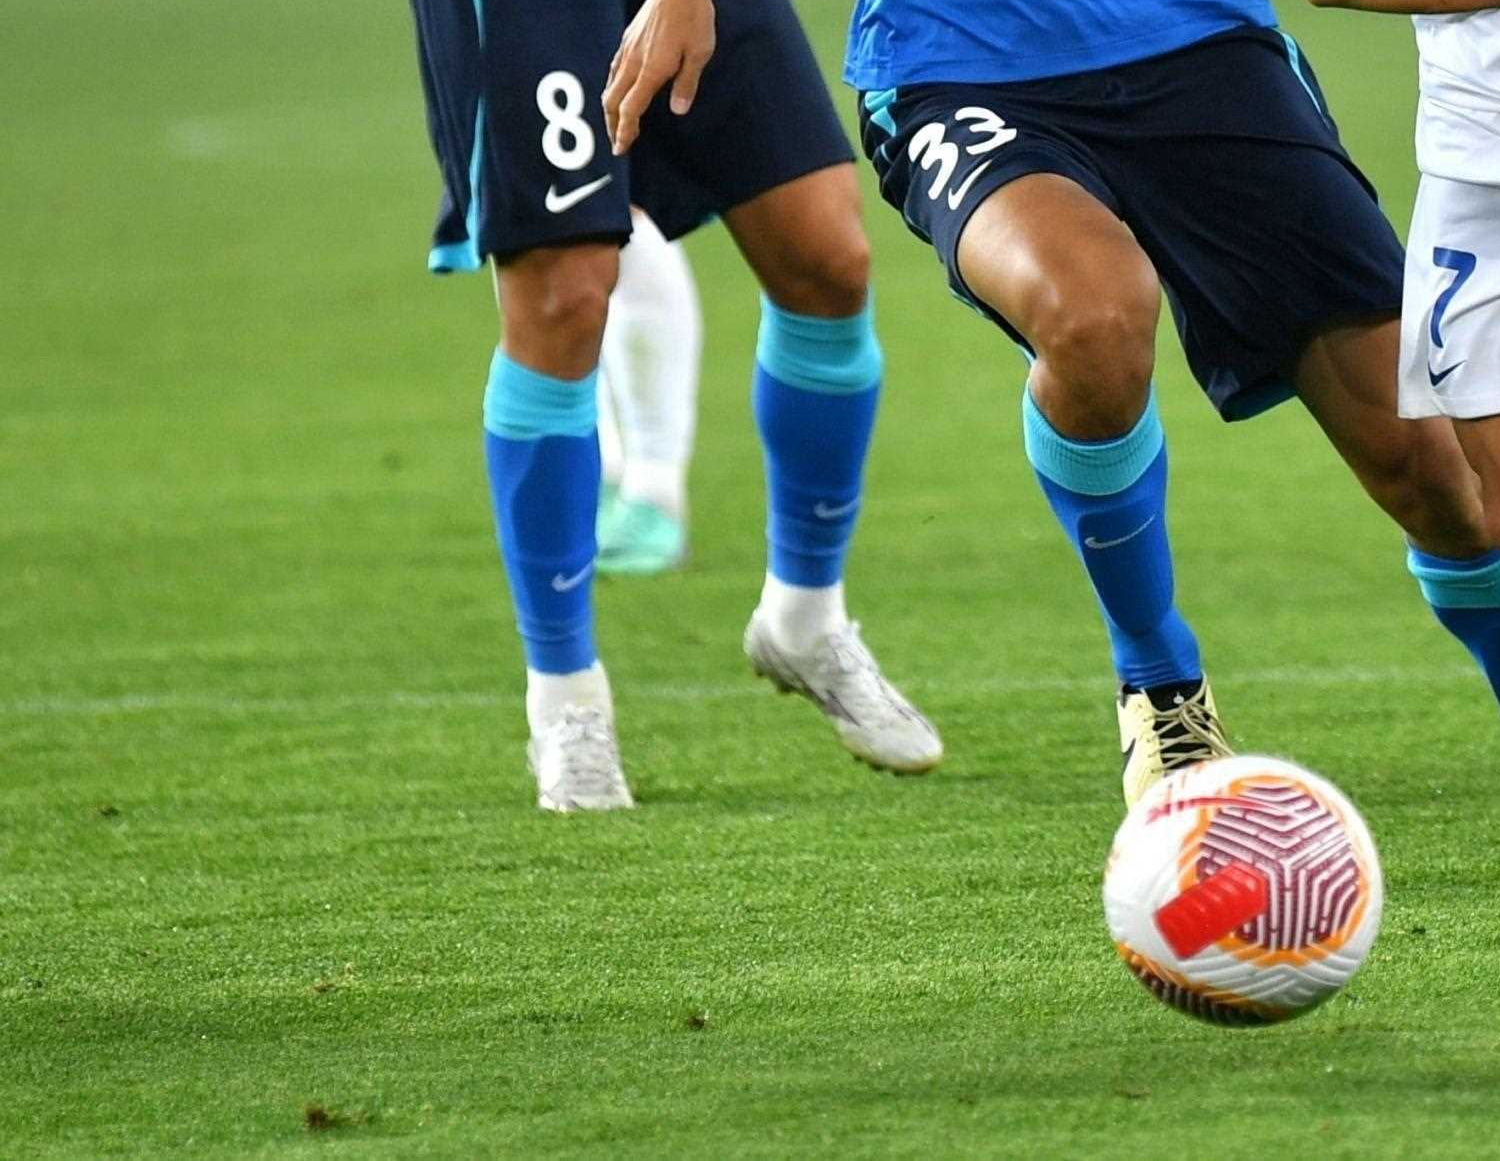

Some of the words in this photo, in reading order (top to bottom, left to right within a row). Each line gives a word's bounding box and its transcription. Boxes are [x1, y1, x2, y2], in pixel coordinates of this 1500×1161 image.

[536, 70, 595, 170] 8
[908, 106, 1018, 200] 33
[1430, 246, 1477, 349] 7
